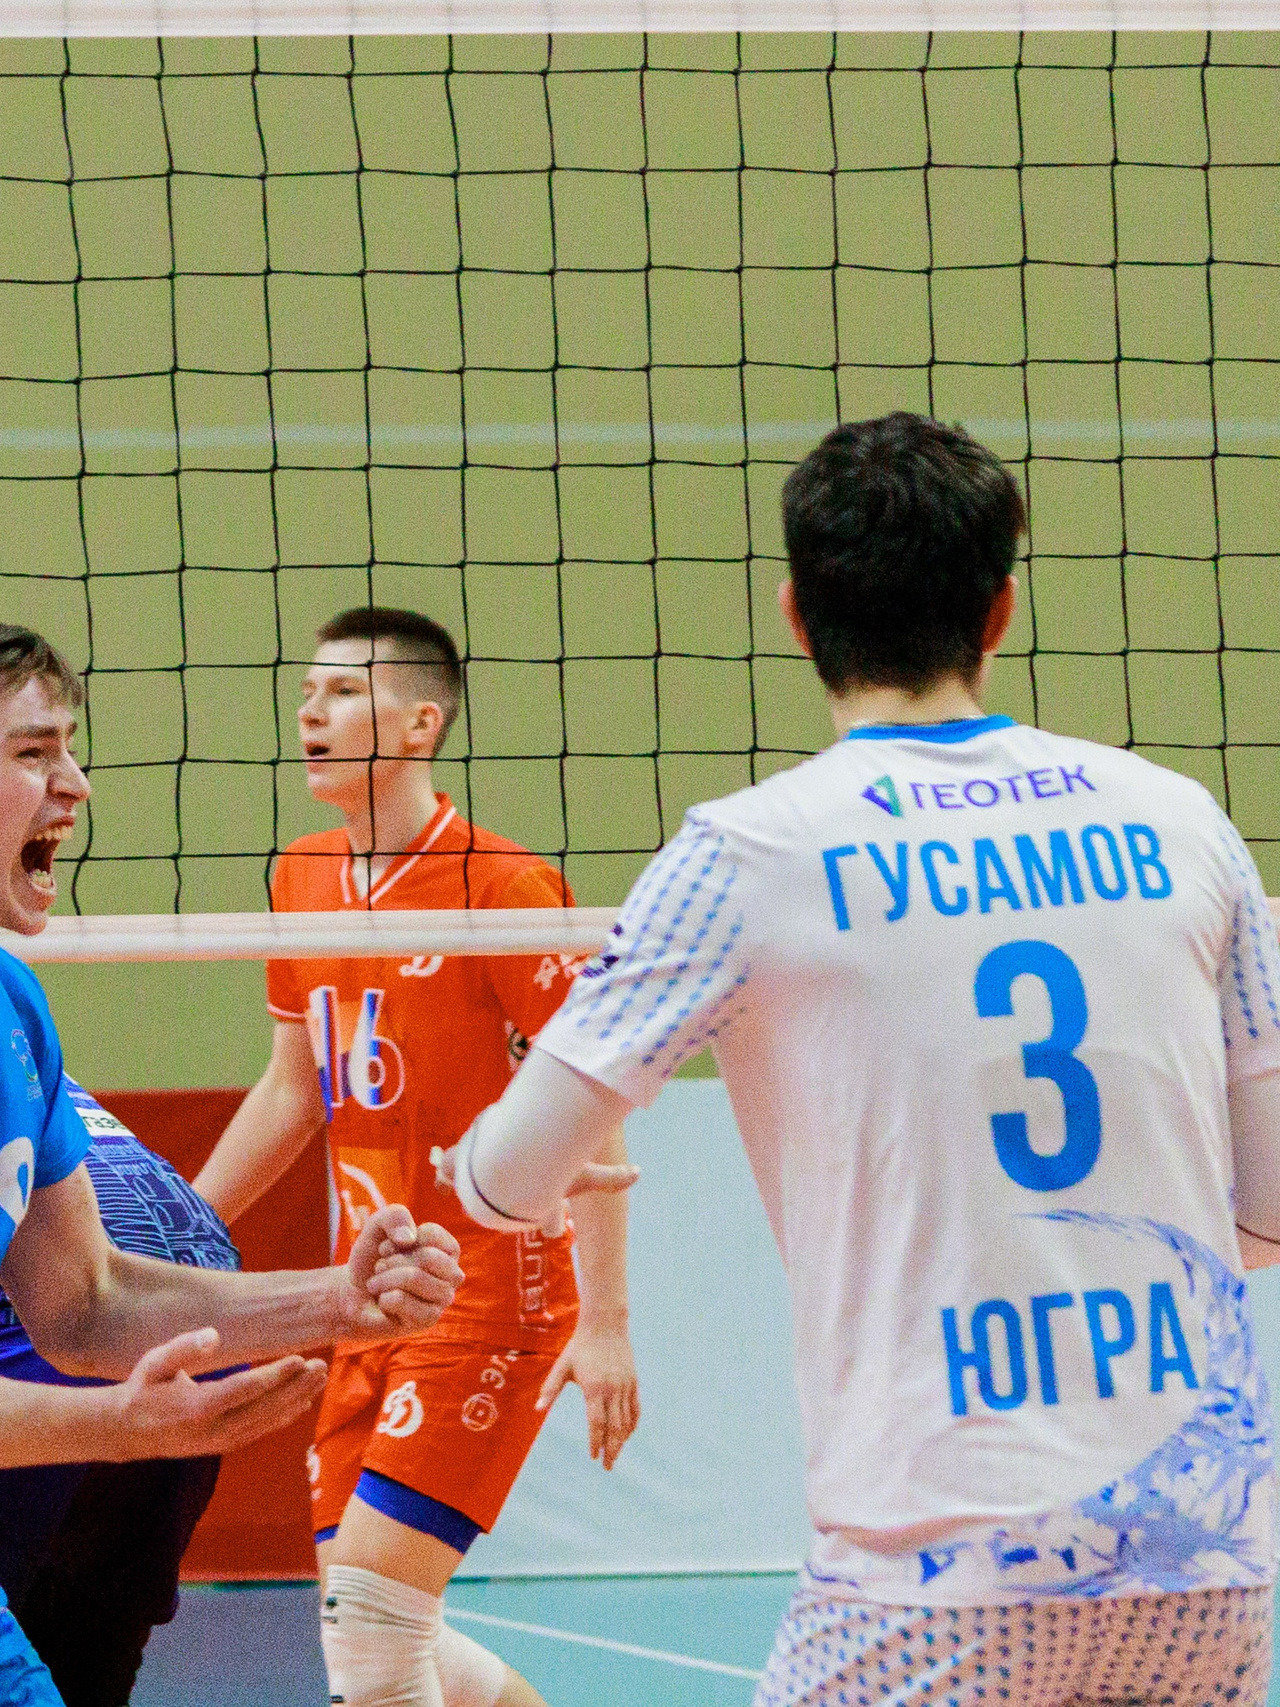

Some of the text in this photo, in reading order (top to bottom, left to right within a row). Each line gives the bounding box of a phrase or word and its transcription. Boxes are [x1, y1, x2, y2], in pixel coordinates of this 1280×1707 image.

[908, 765, 1096, 812] ГЕОТЕК
[822, 823, 1174, 932] ГУСАМОВ
[309, 986, 405, 1111] 16
[973, 940, 1103, 1192] 3
[940, 1282, 1200, 1417] ЮГРА
